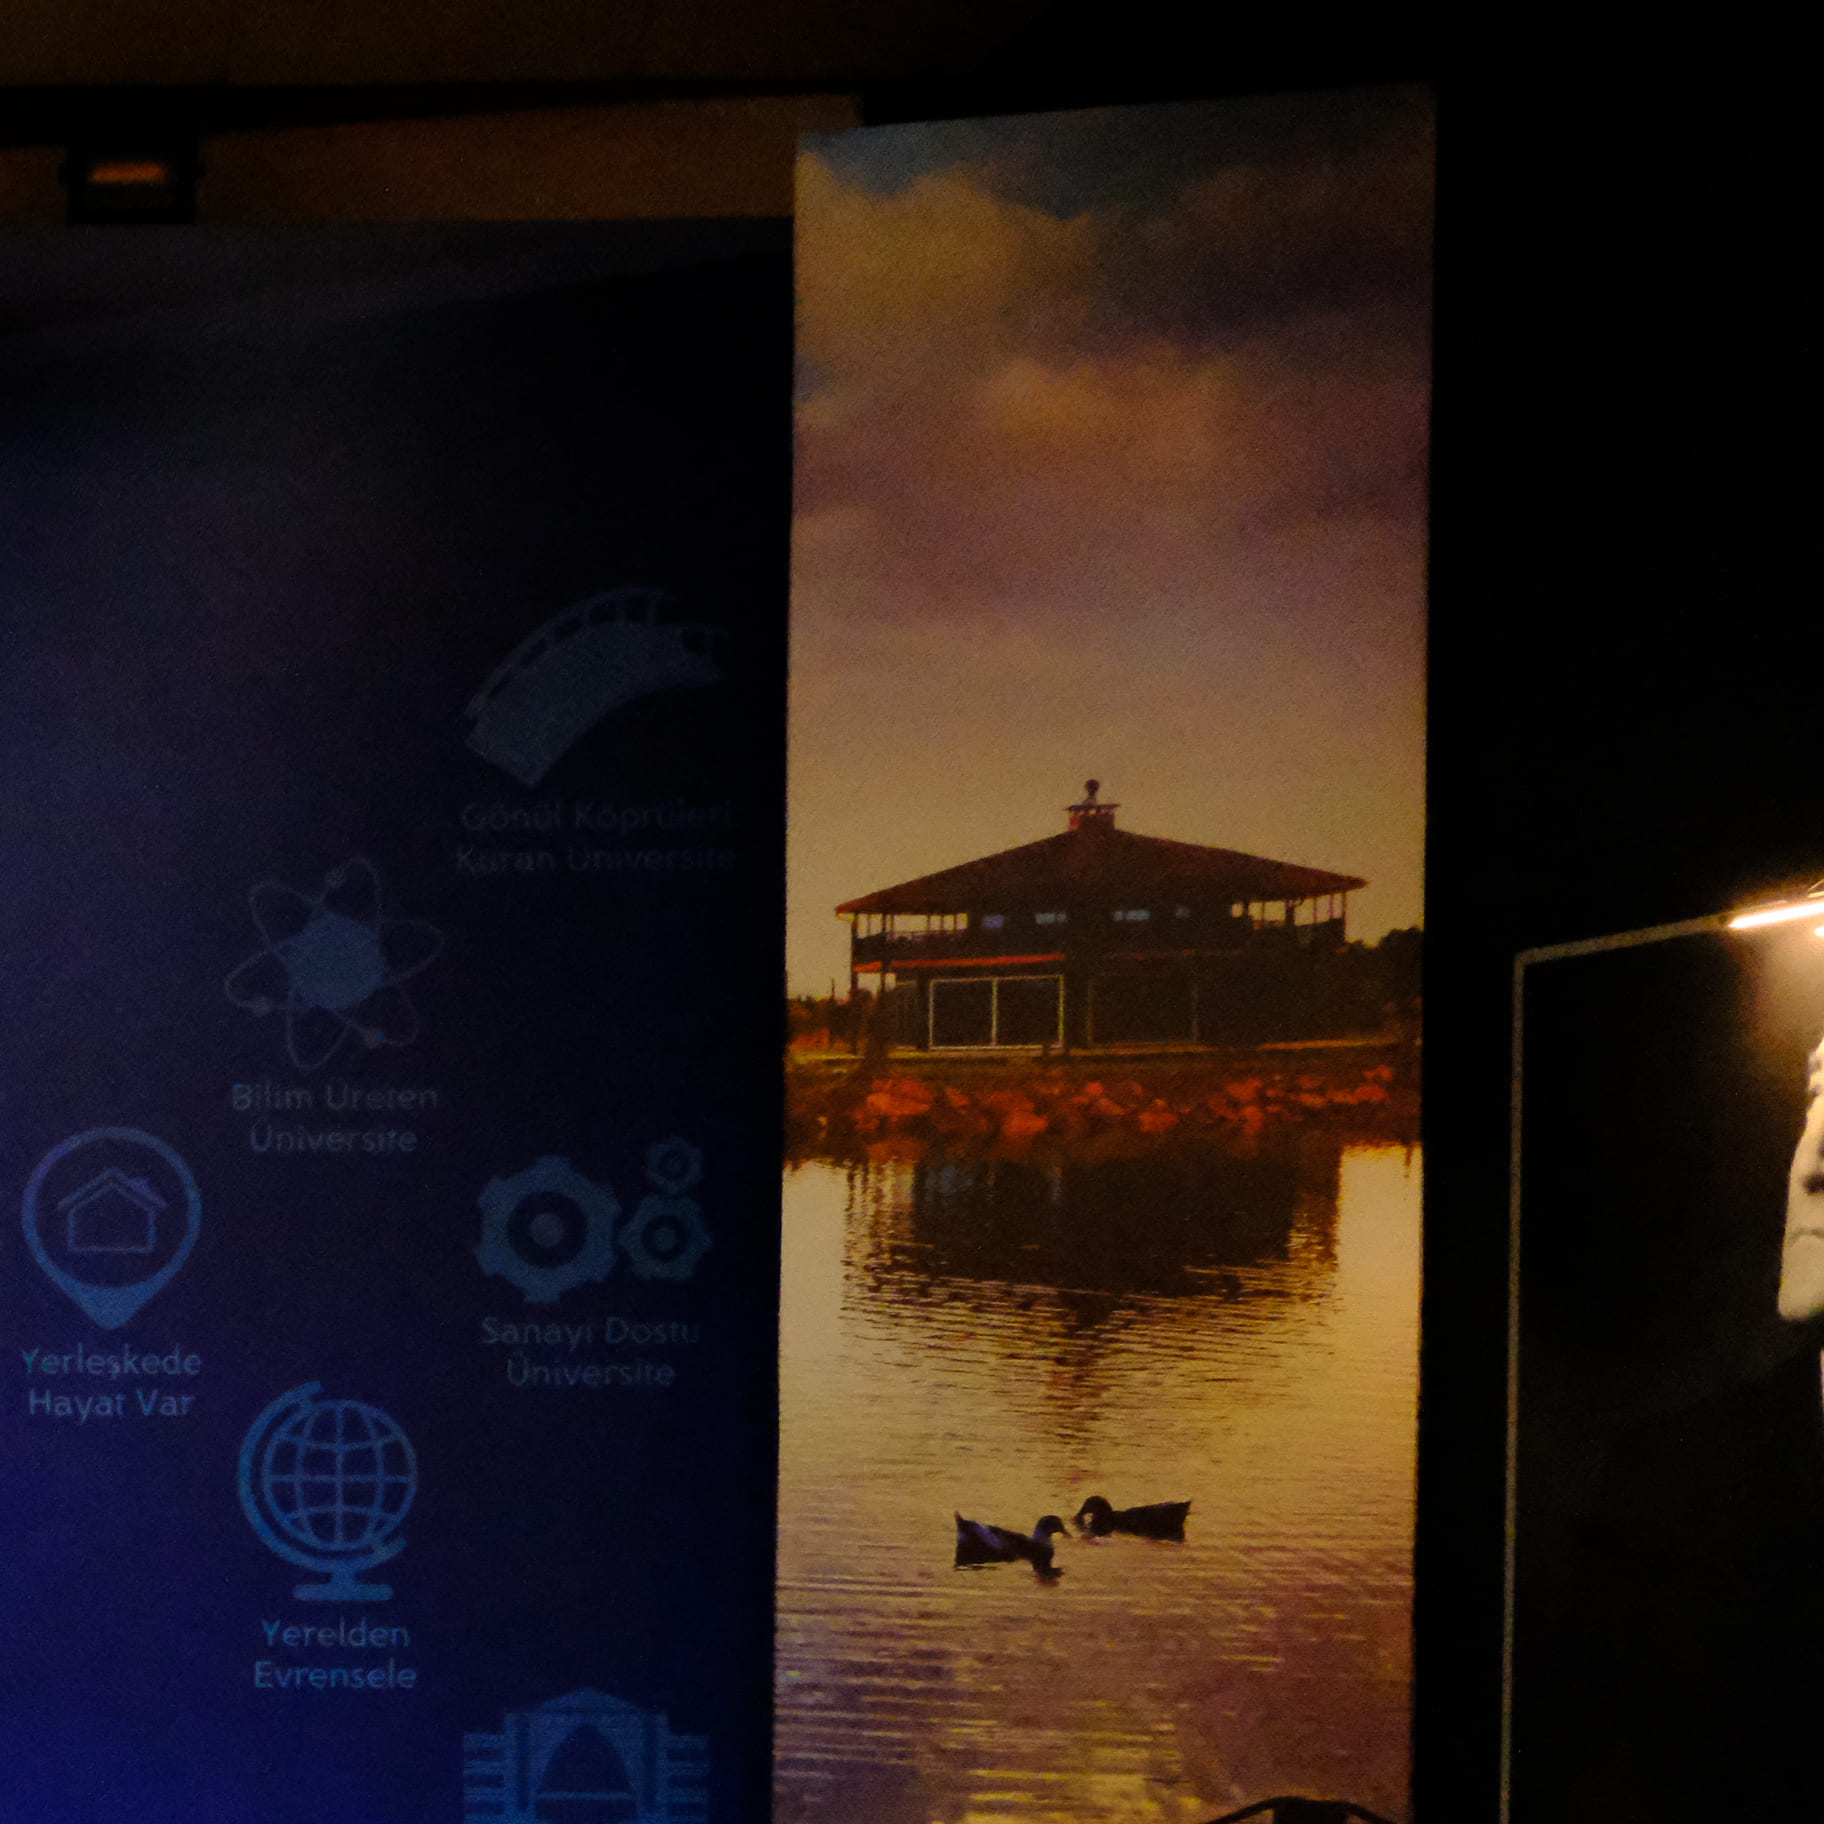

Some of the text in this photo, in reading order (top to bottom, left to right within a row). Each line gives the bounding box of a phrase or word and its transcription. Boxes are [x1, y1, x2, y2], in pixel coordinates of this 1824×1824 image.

[231, 1079, 315, 1112] Bilim
[250, 1117, 419, 1155] Üniversite
[480, 1315, 596, 1350] Sanayi
[21, 1343, 202, 1381] Yerleşkede
[506, 1354, 676, 1388] Üniversite
[27, 1387, 194, 1424] Hayat Var
[261, 1618, 411, 1650] Yerelden
[253, 1661, 418, 1692] Evrensele
